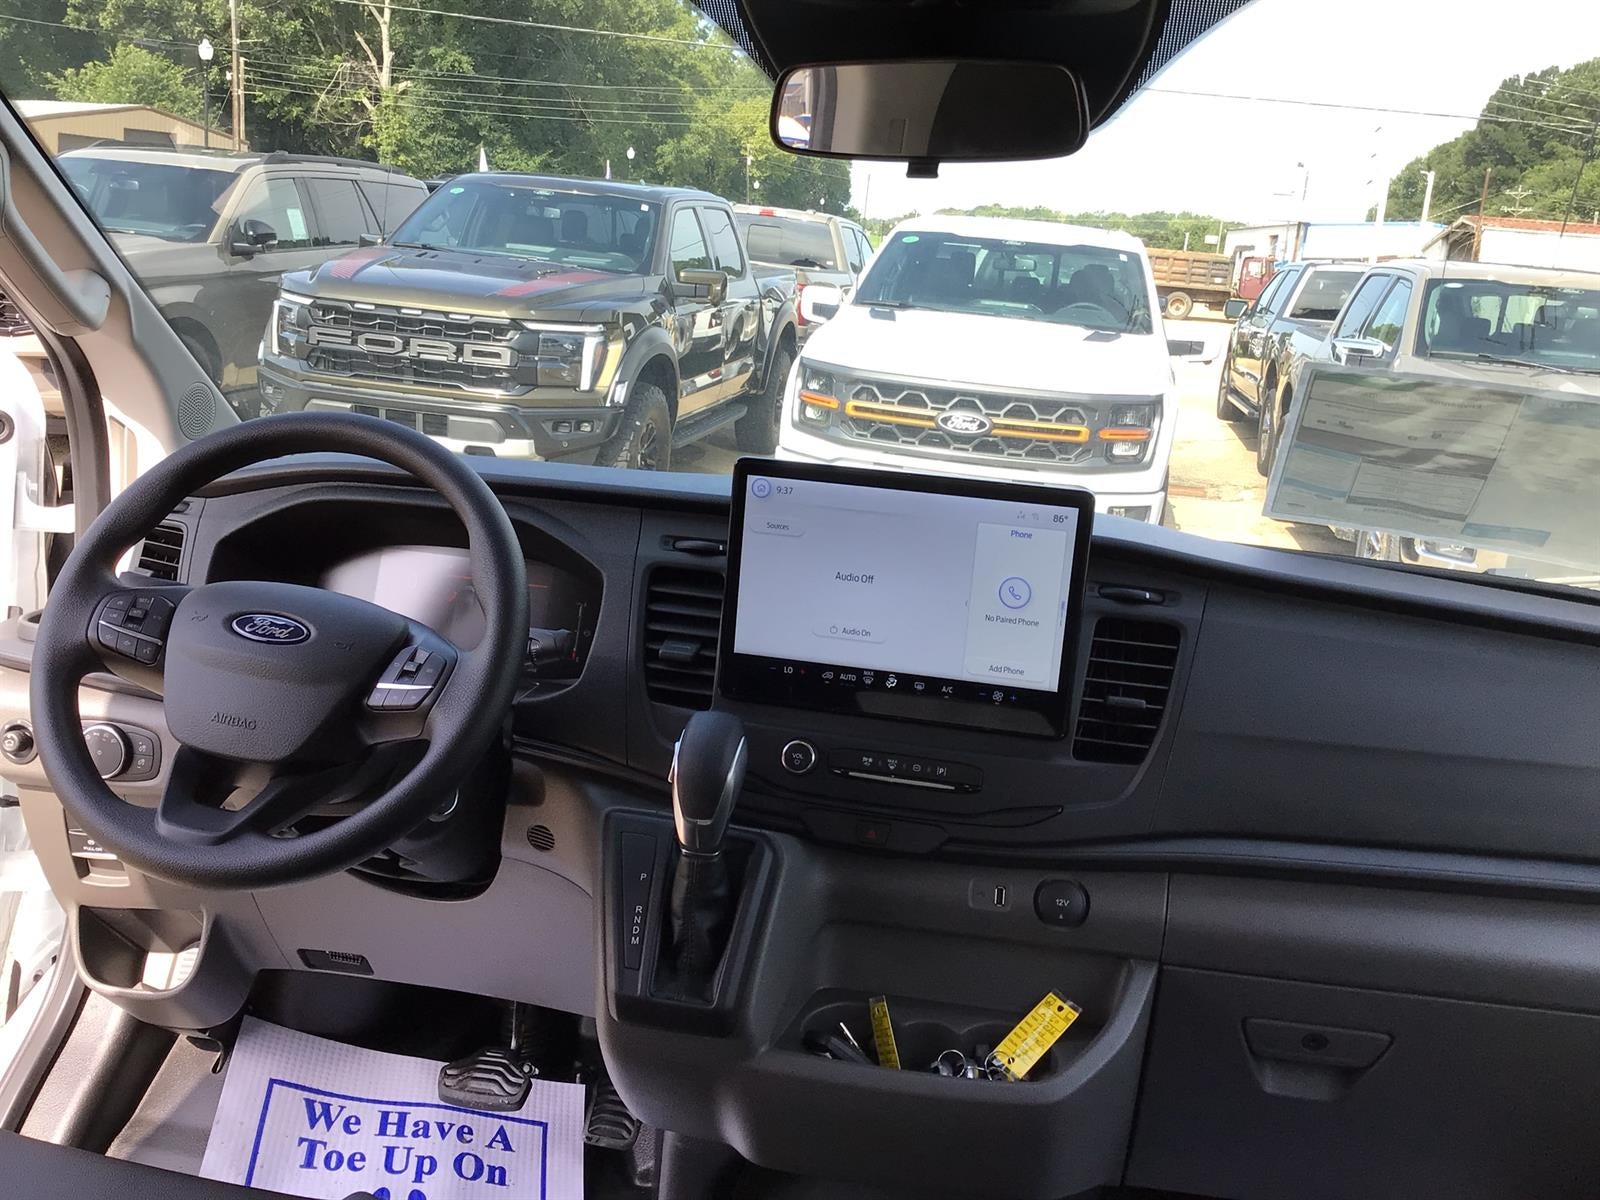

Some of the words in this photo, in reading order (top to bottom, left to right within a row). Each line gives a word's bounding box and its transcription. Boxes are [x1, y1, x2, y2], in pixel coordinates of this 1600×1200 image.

[306, 325, 520, 369] FORD
[946, 414, 981, 432] Ford
[766, 521, 790, 531] Sources
[1010, 529, 1033, 540] Phone
[835, 571, 860, 583] Audio
[860, 574, 875, 584] Off
[984, 613, 995, 623] No
[995, 615, 1017, 626] Paired
[1017, 617, 1040, 628] Phone
[244, 615, 295, 640] Ford
[842, 626, 861, 637] Audio
[861, 629, 872, 638] On
[783, 665, 794, 675] LO
[988, 664, 1003, 674] Add
[1003, 666, 1025, 676] Phone
[839, 672, 857, 683] AUTO
[941, 684, 953, 695] A/C
[211, 711, 258, 731] AIRBAG
[792, 752, 804, 760] VOL
[640, 872, 647, 881] P
[1055, 898, 1070, 907] 12V
[302, 1097, 362, 1136] We
[374, 1110, 474, 1145] Have
[485, 1124, 516, 1153] A
[297, 1136, 367, 1173] Toe
[382, 1145, 438, 1184] Up
[452, 1151, 510, 1187] On
